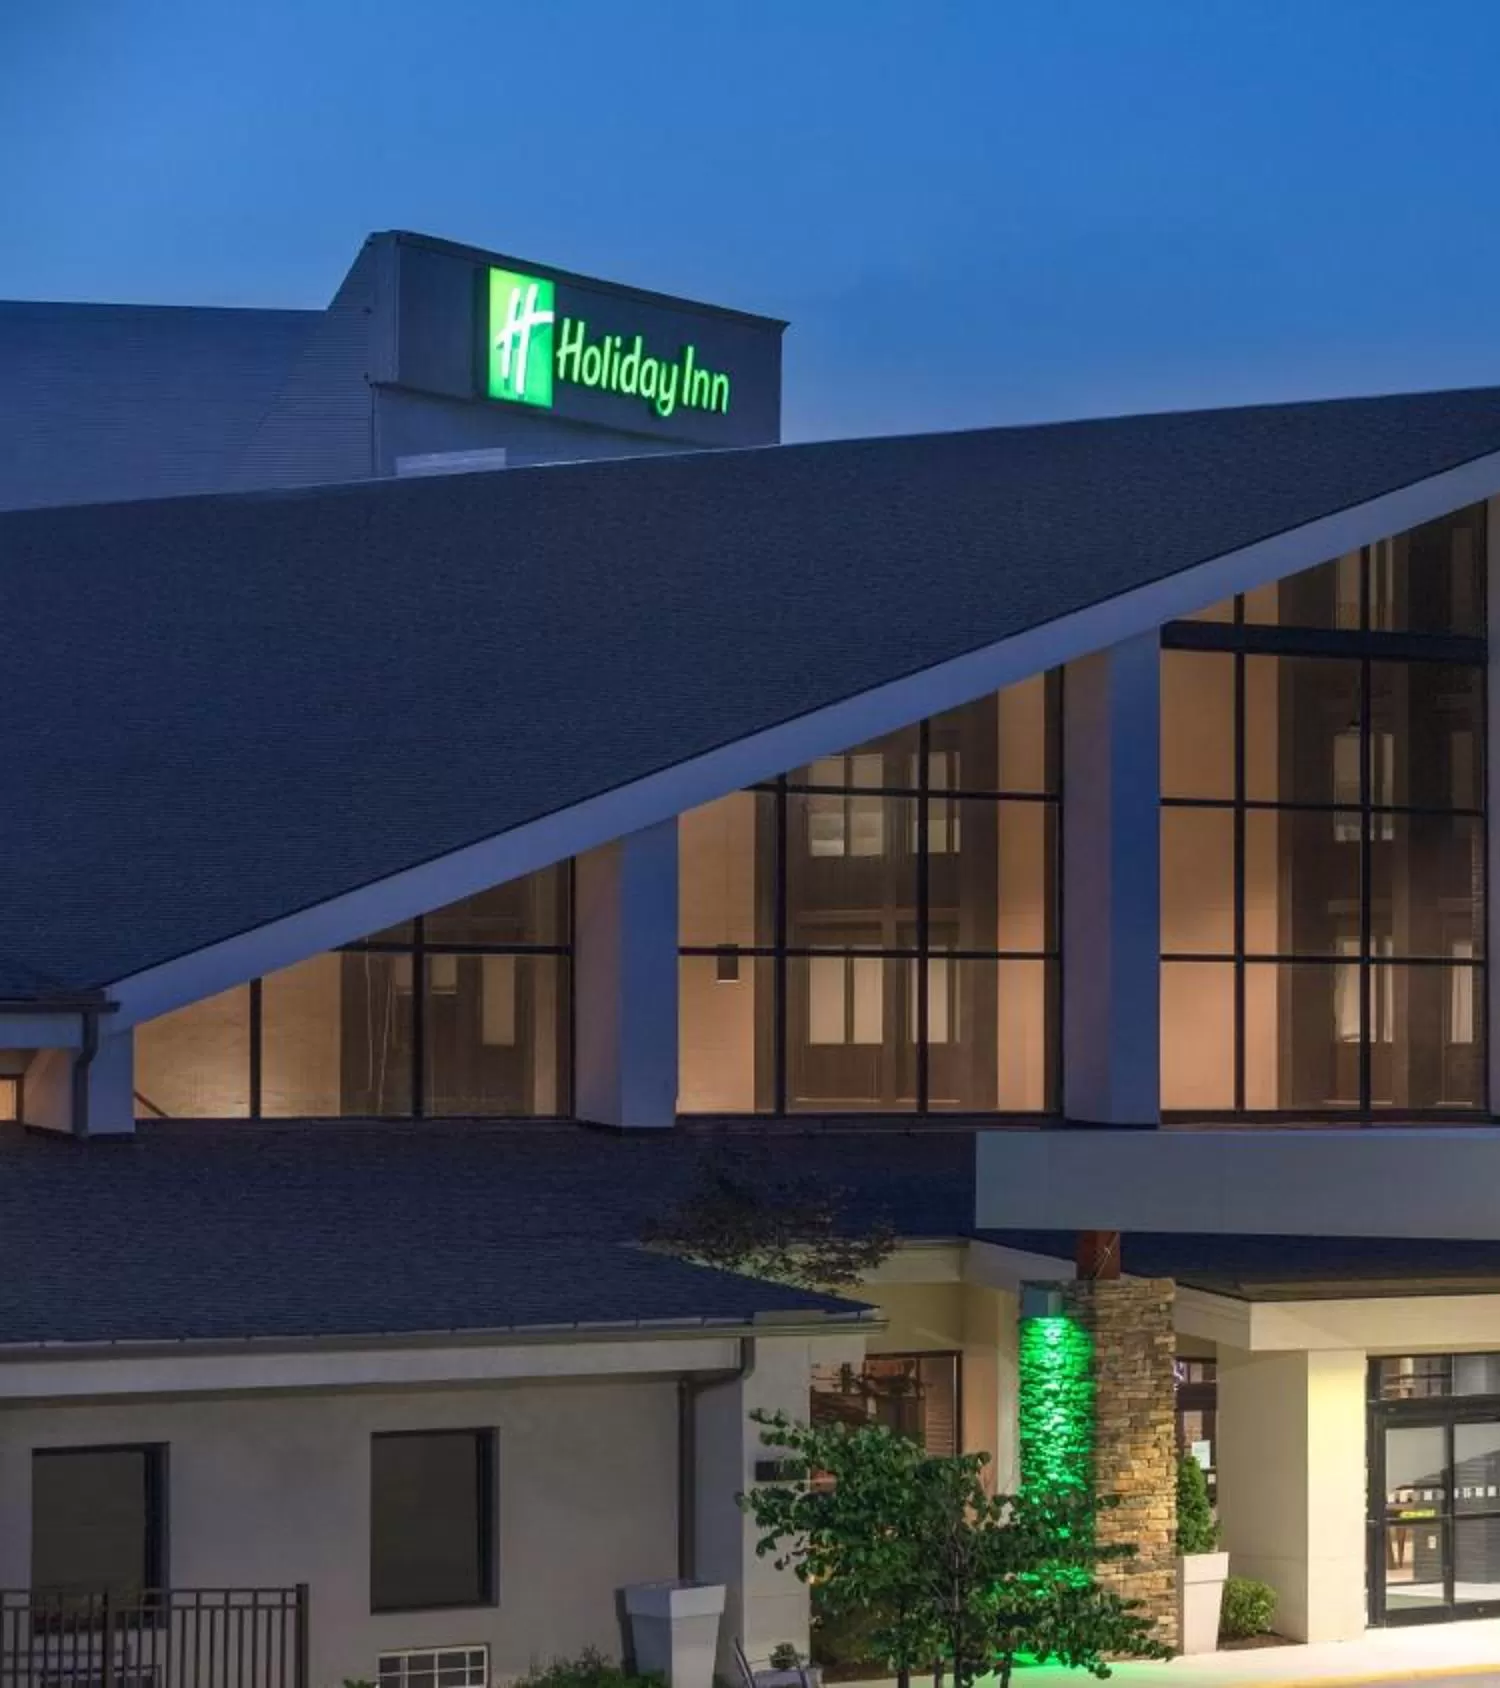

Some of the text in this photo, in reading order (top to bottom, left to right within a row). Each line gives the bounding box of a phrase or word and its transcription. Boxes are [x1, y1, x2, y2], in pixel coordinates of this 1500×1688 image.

[495, 283, 554, 395] H
[557, 317, 730, 416] Holiday Inn
